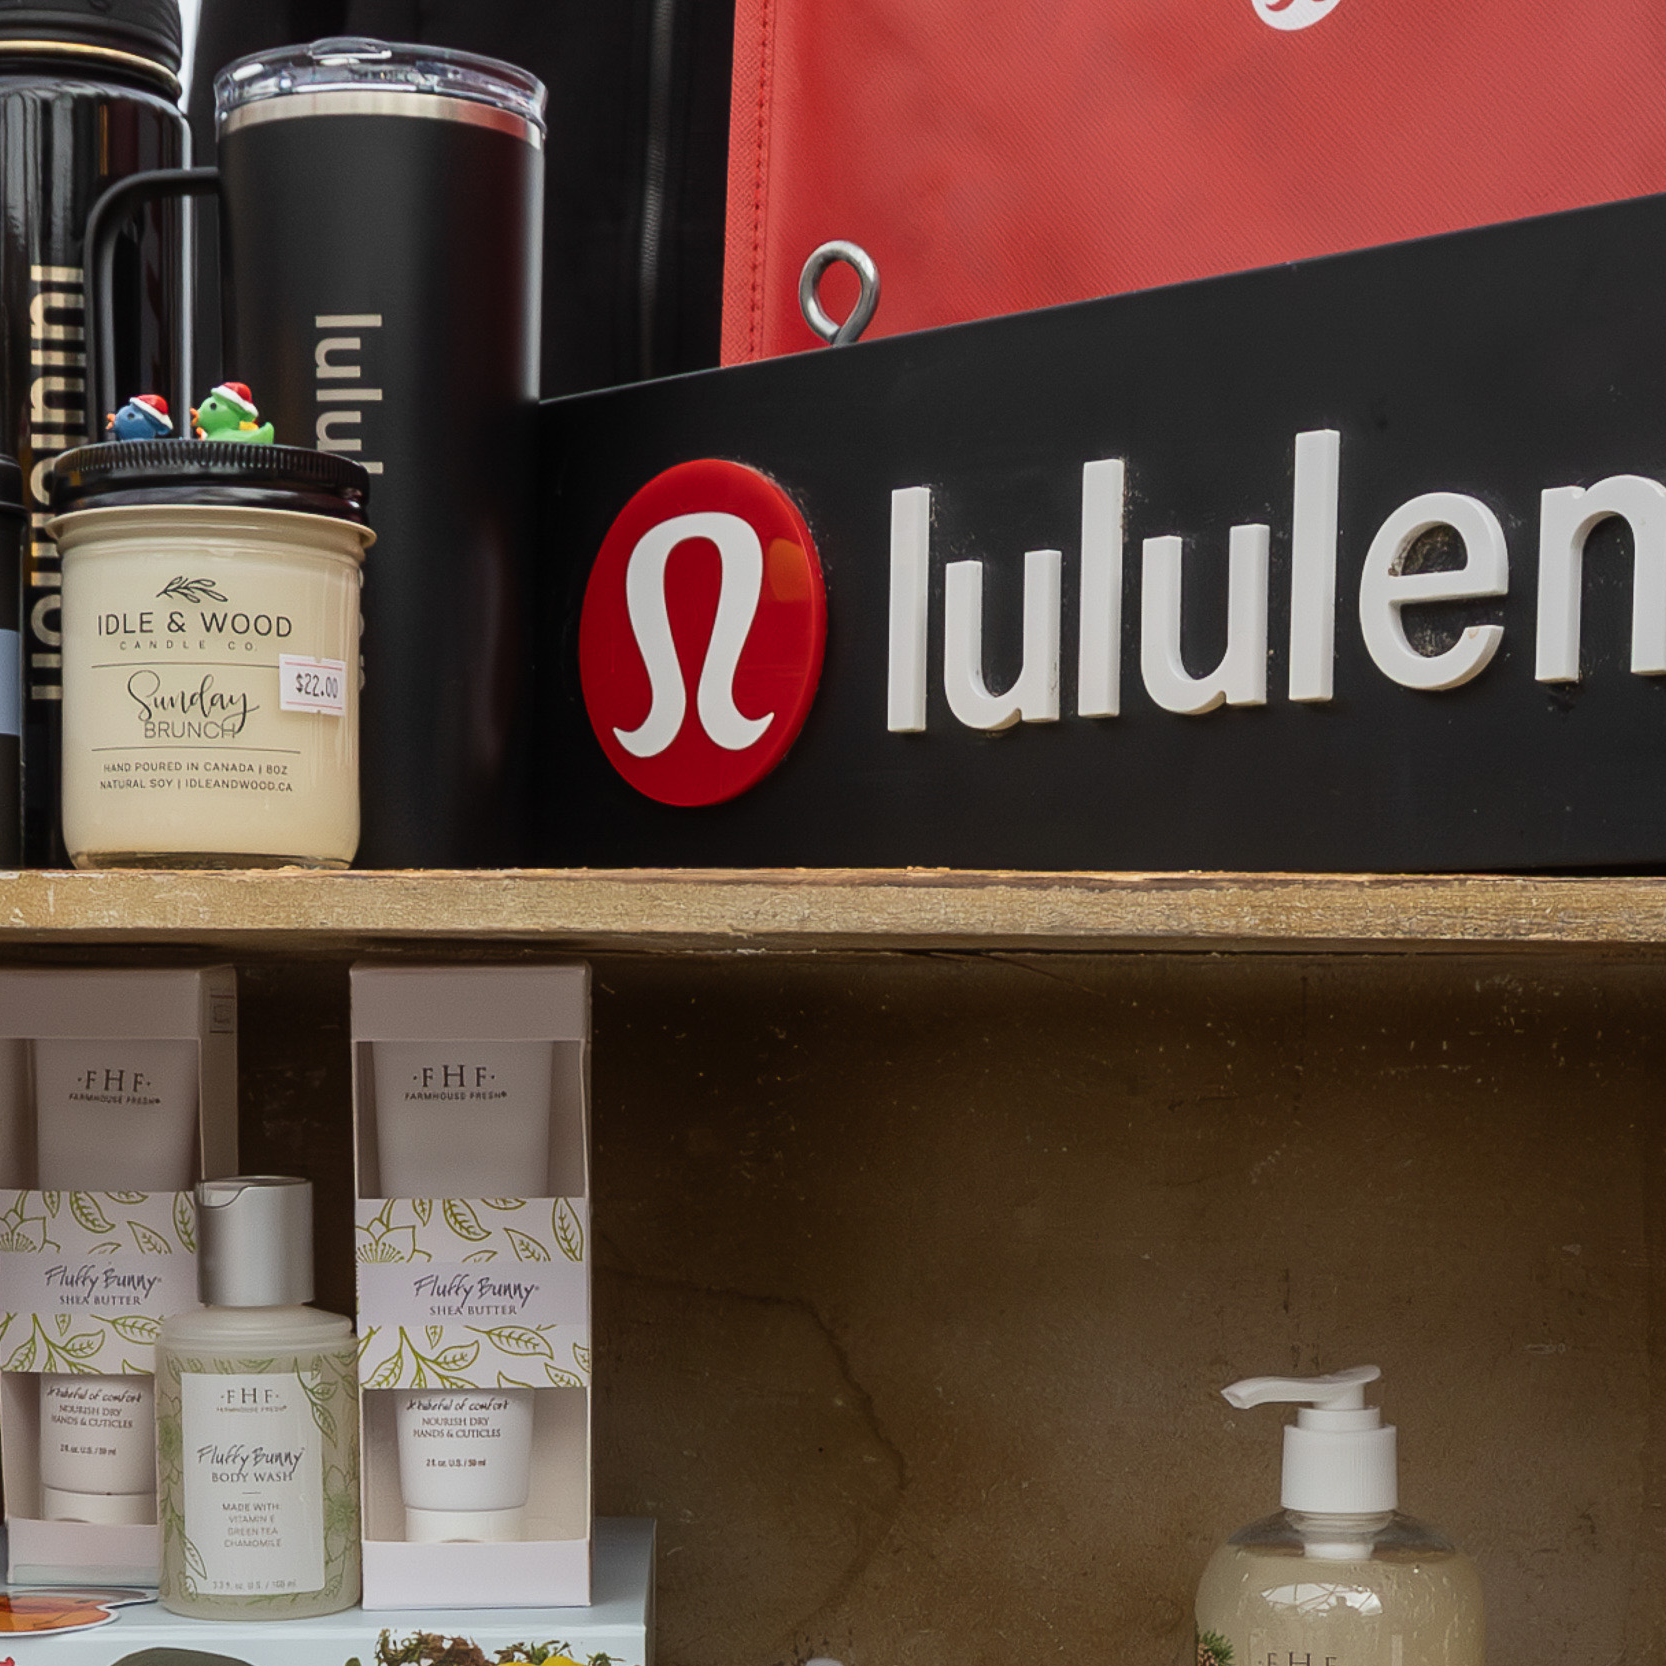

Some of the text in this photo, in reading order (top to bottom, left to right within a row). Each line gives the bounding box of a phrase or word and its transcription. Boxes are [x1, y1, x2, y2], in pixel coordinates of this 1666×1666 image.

[98, 611, 293, 637] IDLE & WOOD
[120, 640, 257, 651] CANDLE CO.
[295, 672, 339, 699] $22.00
[127, 669, 261, 735] Sunday
[144, 721, 236, 739] BRUNCH
[104, 761, 254, 774] HAND POURED IN CANADA
[100, 779, 293, 792] NATURAL SOY IDLEANDWOOD.CA
[85, 1068, 145, 1093] FHF
[422, 1064, 487, 1090] FHF
[45, 1264, 157, 1299] Fluffy Bunny
[413, 1274, 535, 1309] Fluffy Bunny
[94, 1295, 141, 1306] BUTTER
[429, 1305, 518, 1316] SHEA BUTTER
[226, 1387, 273, 1404] FHF
[196, 1444, 302, 1476] Fluffy Bunny
[211, 1471, 294, 1483] BODY WASH
